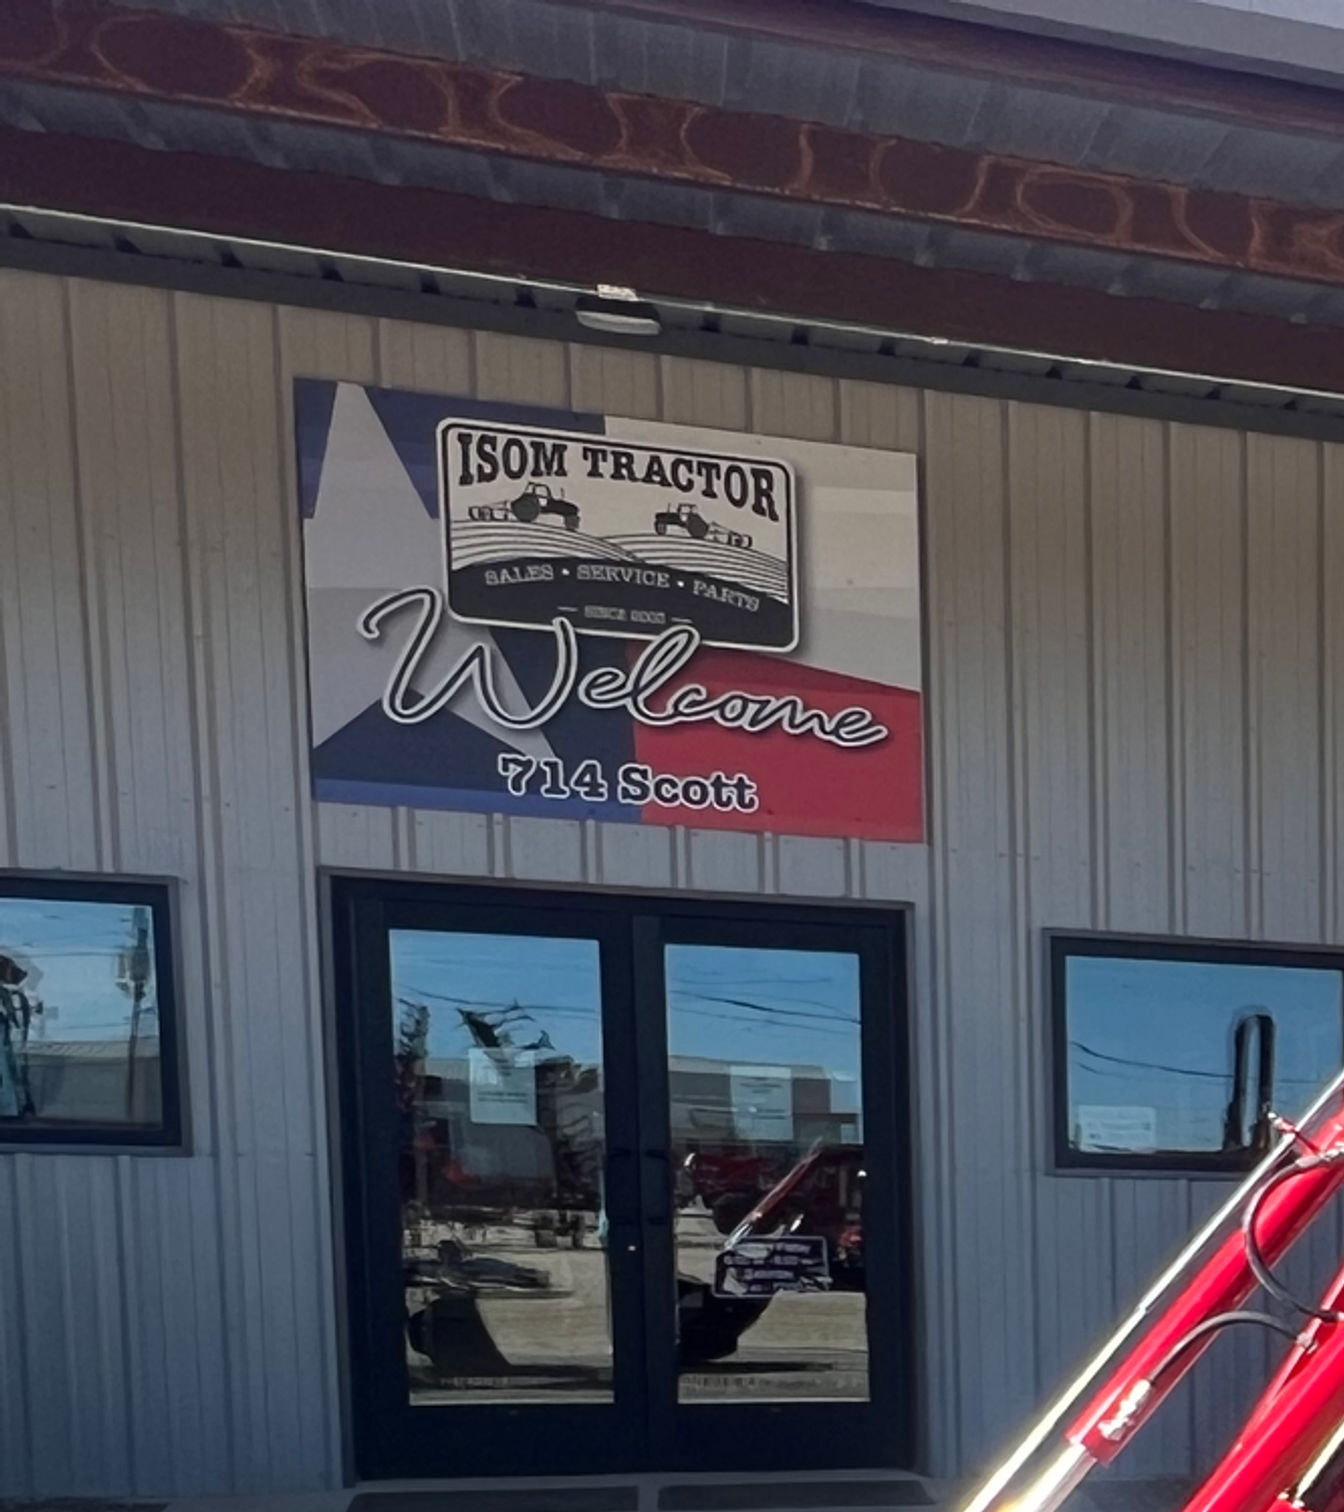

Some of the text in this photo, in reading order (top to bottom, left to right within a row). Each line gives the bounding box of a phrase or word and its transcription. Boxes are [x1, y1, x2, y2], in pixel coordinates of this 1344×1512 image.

[457, 432, 779, 522] ISOM TRACTOR
[485, 564, 761, 612] SALES SERVICE PARTS
[360, 588, 887, 746] Welcome
[499, 754, 759, 811] 714 Scott
